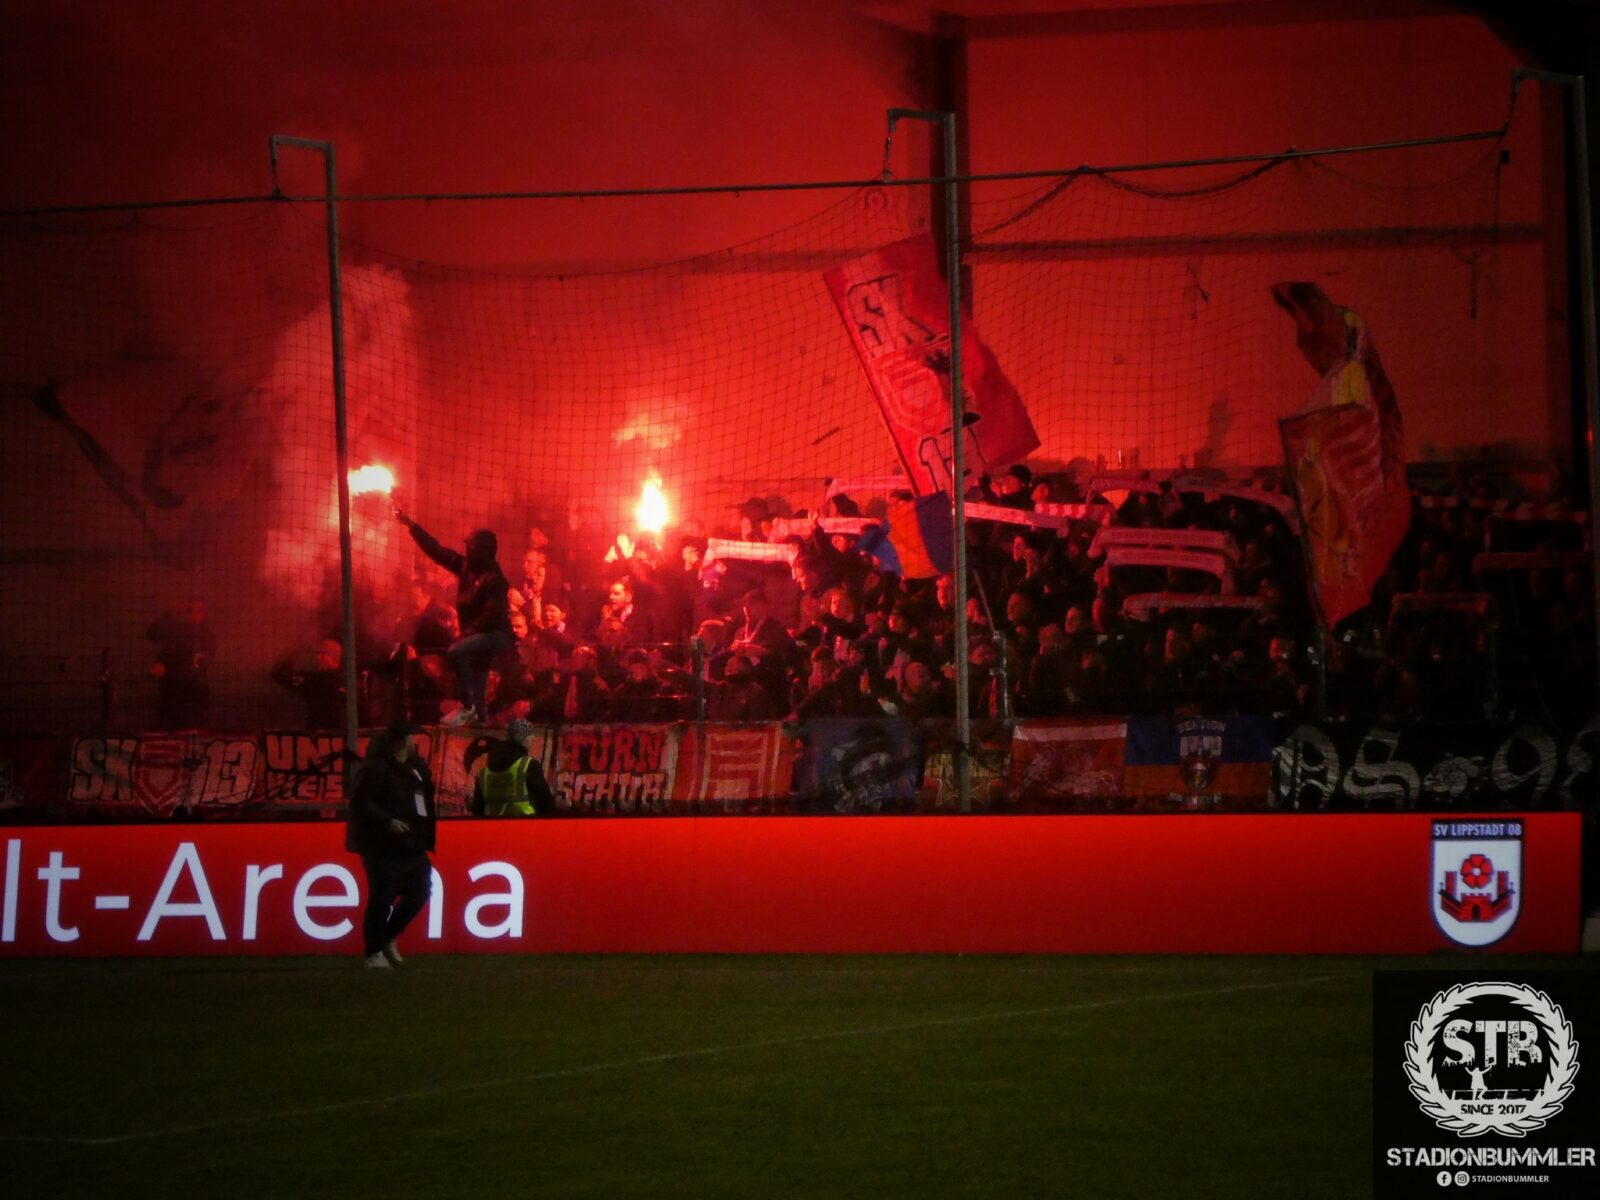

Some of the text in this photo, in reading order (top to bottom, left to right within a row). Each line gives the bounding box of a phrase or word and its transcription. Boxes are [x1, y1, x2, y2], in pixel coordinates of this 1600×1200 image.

[199, 739, 258, 805] 13
[560, 730, 665, 773] TURN
[1434, 823, 1522, 836] SV LIPPSTADT 08
